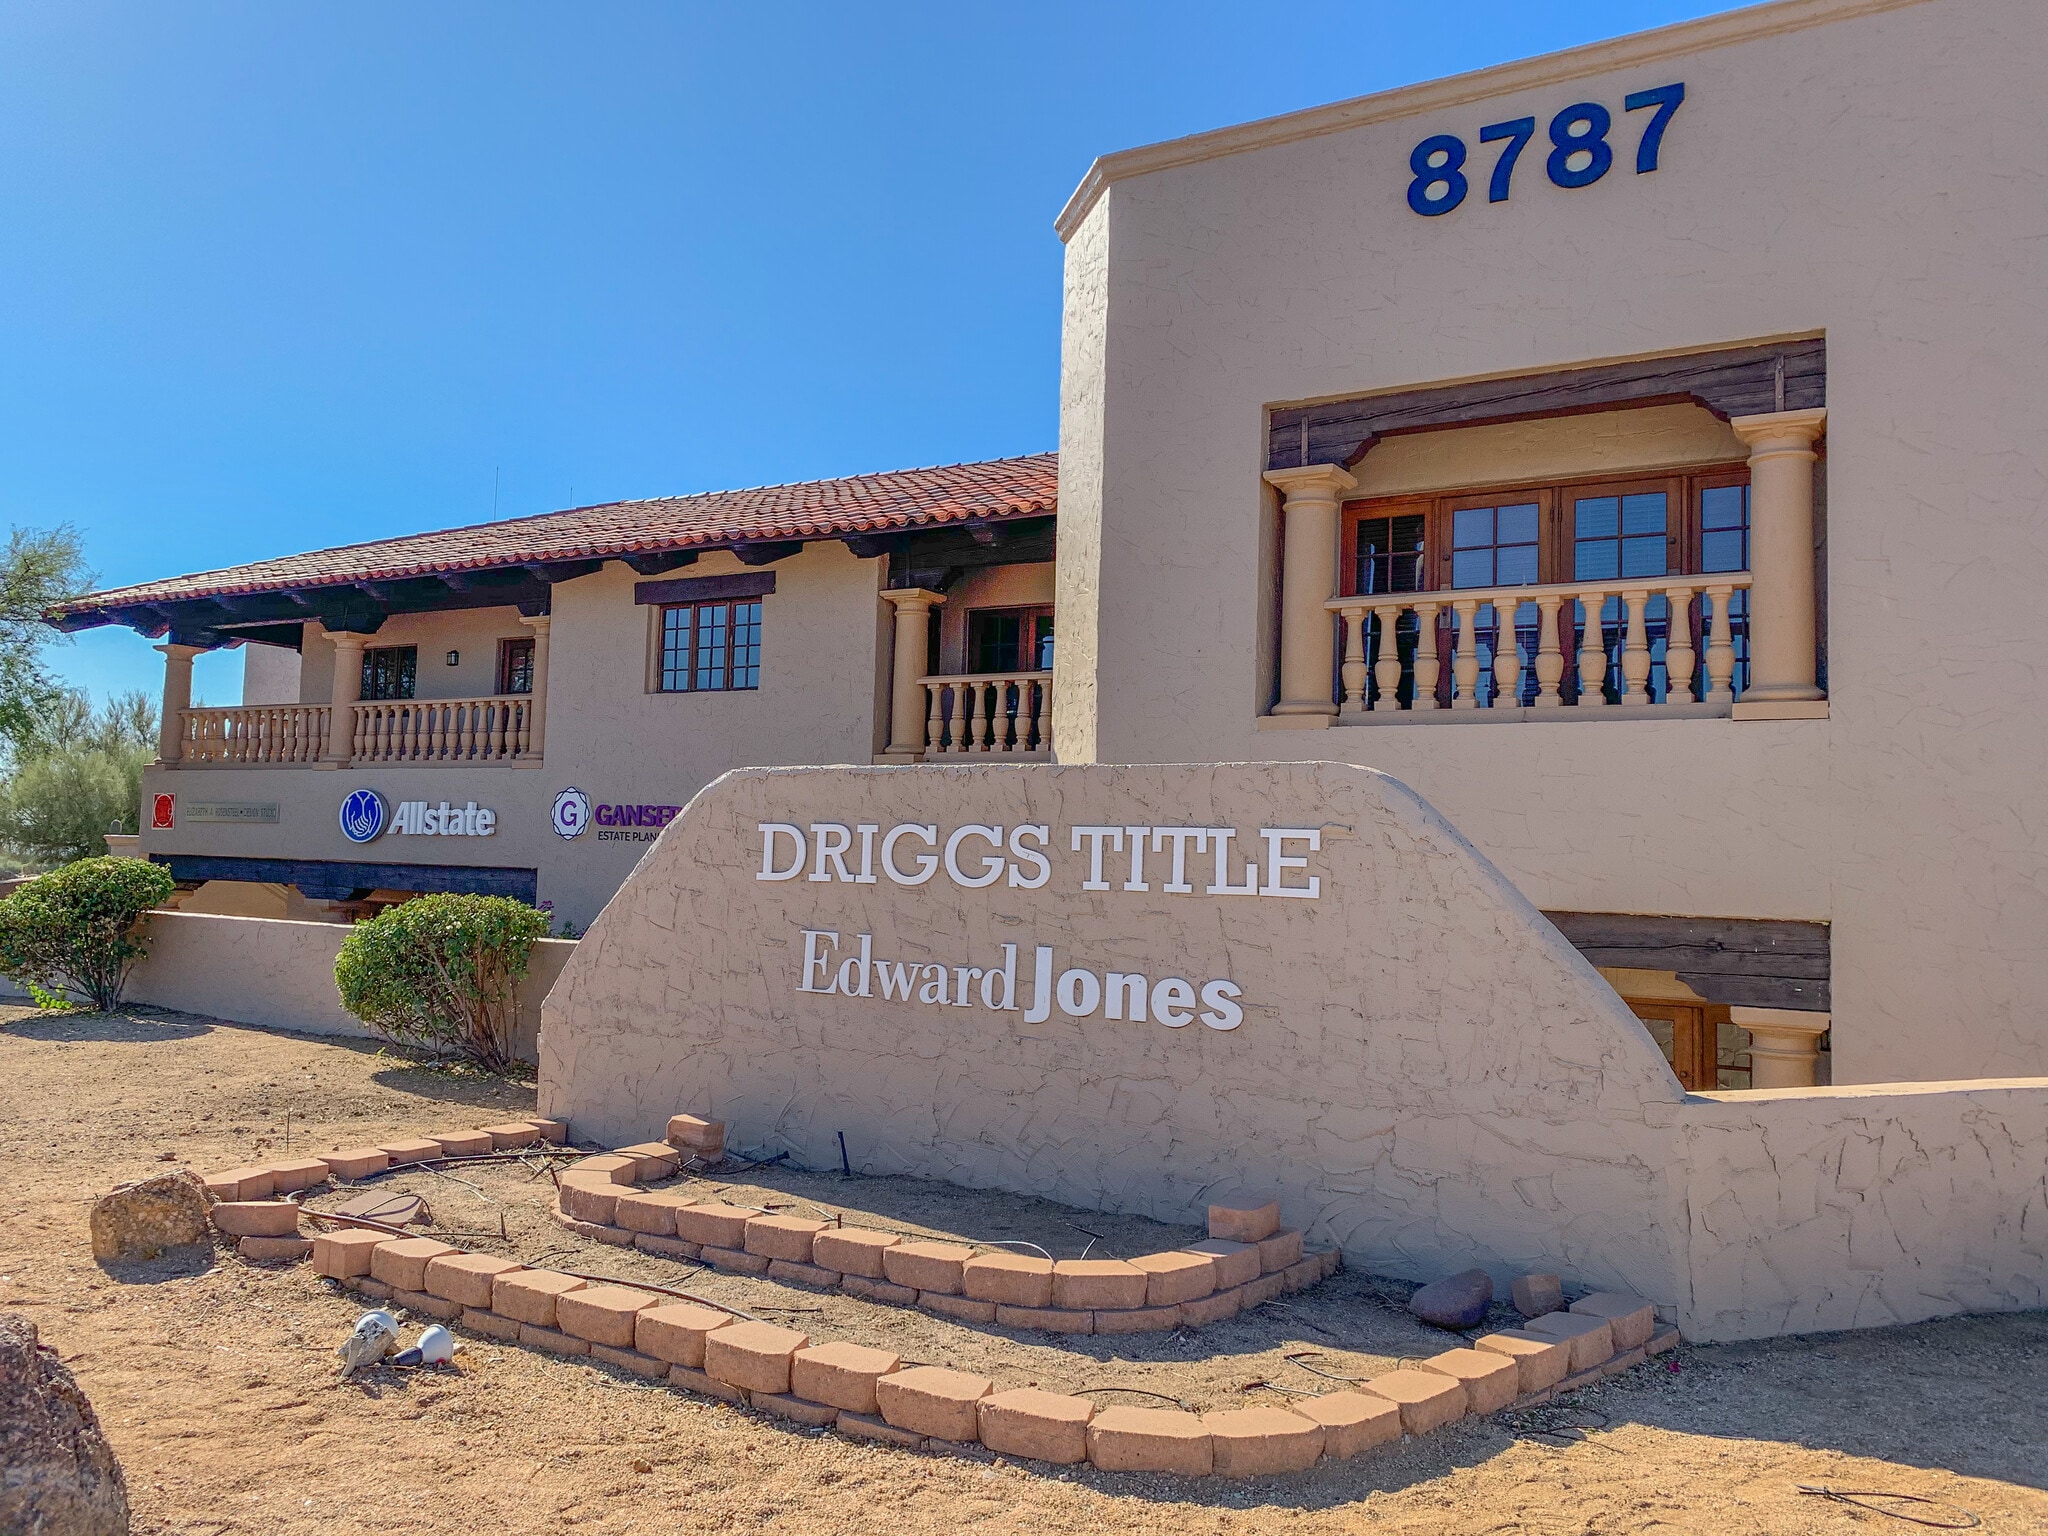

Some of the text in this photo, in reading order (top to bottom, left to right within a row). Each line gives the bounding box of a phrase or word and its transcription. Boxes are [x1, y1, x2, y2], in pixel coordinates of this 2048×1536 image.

[1407, 82, 1685, 216] 8787
[387, 801, 496, 836] Allstate
[560, 800, 578, 827] G
[598, 830, 660, 842] ESTATE PLAN
[756, 823, 1321, 899] DRIGGS TITLE
[796, 929, 1244, 1031] Edward Jones
